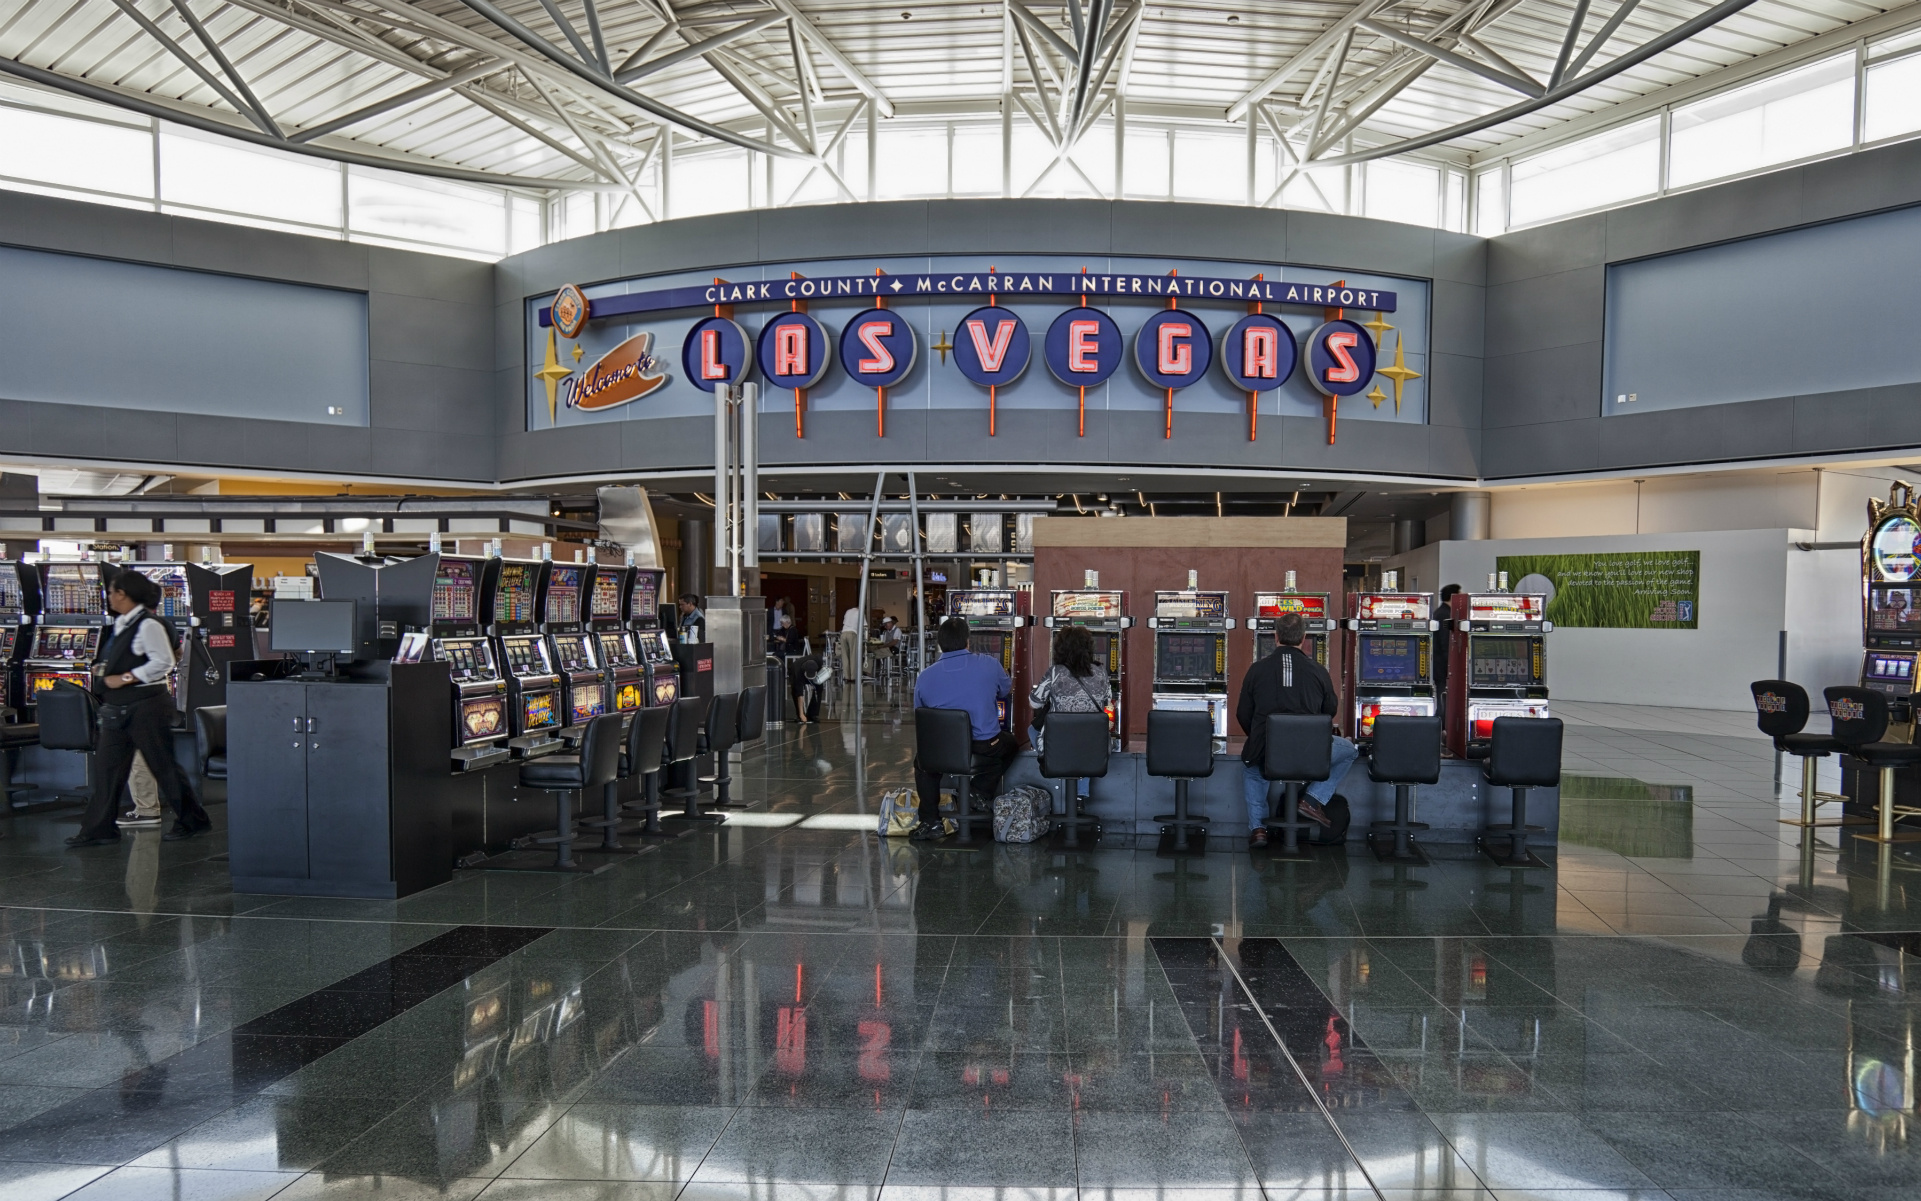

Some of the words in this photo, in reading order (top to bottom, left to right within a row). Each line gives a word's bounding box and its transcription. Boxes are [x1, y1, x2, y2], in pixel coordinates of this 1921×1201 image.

[705, 283, 771, 302] CLARK
[784, 277, 880, 297] COUNTY
[916, 275, 1053, 292] McCARRAN
[1071, 276, 1274, 299] INTERNATIONAL
[1286, 285, 1379, 307] AIRPORT
[965, 318, 1360, 384] VEGAS
[562, 362, 638, 409] Welcome
[637, 350, 656, 372] to
[1676, 568, 1694, 578] shop
